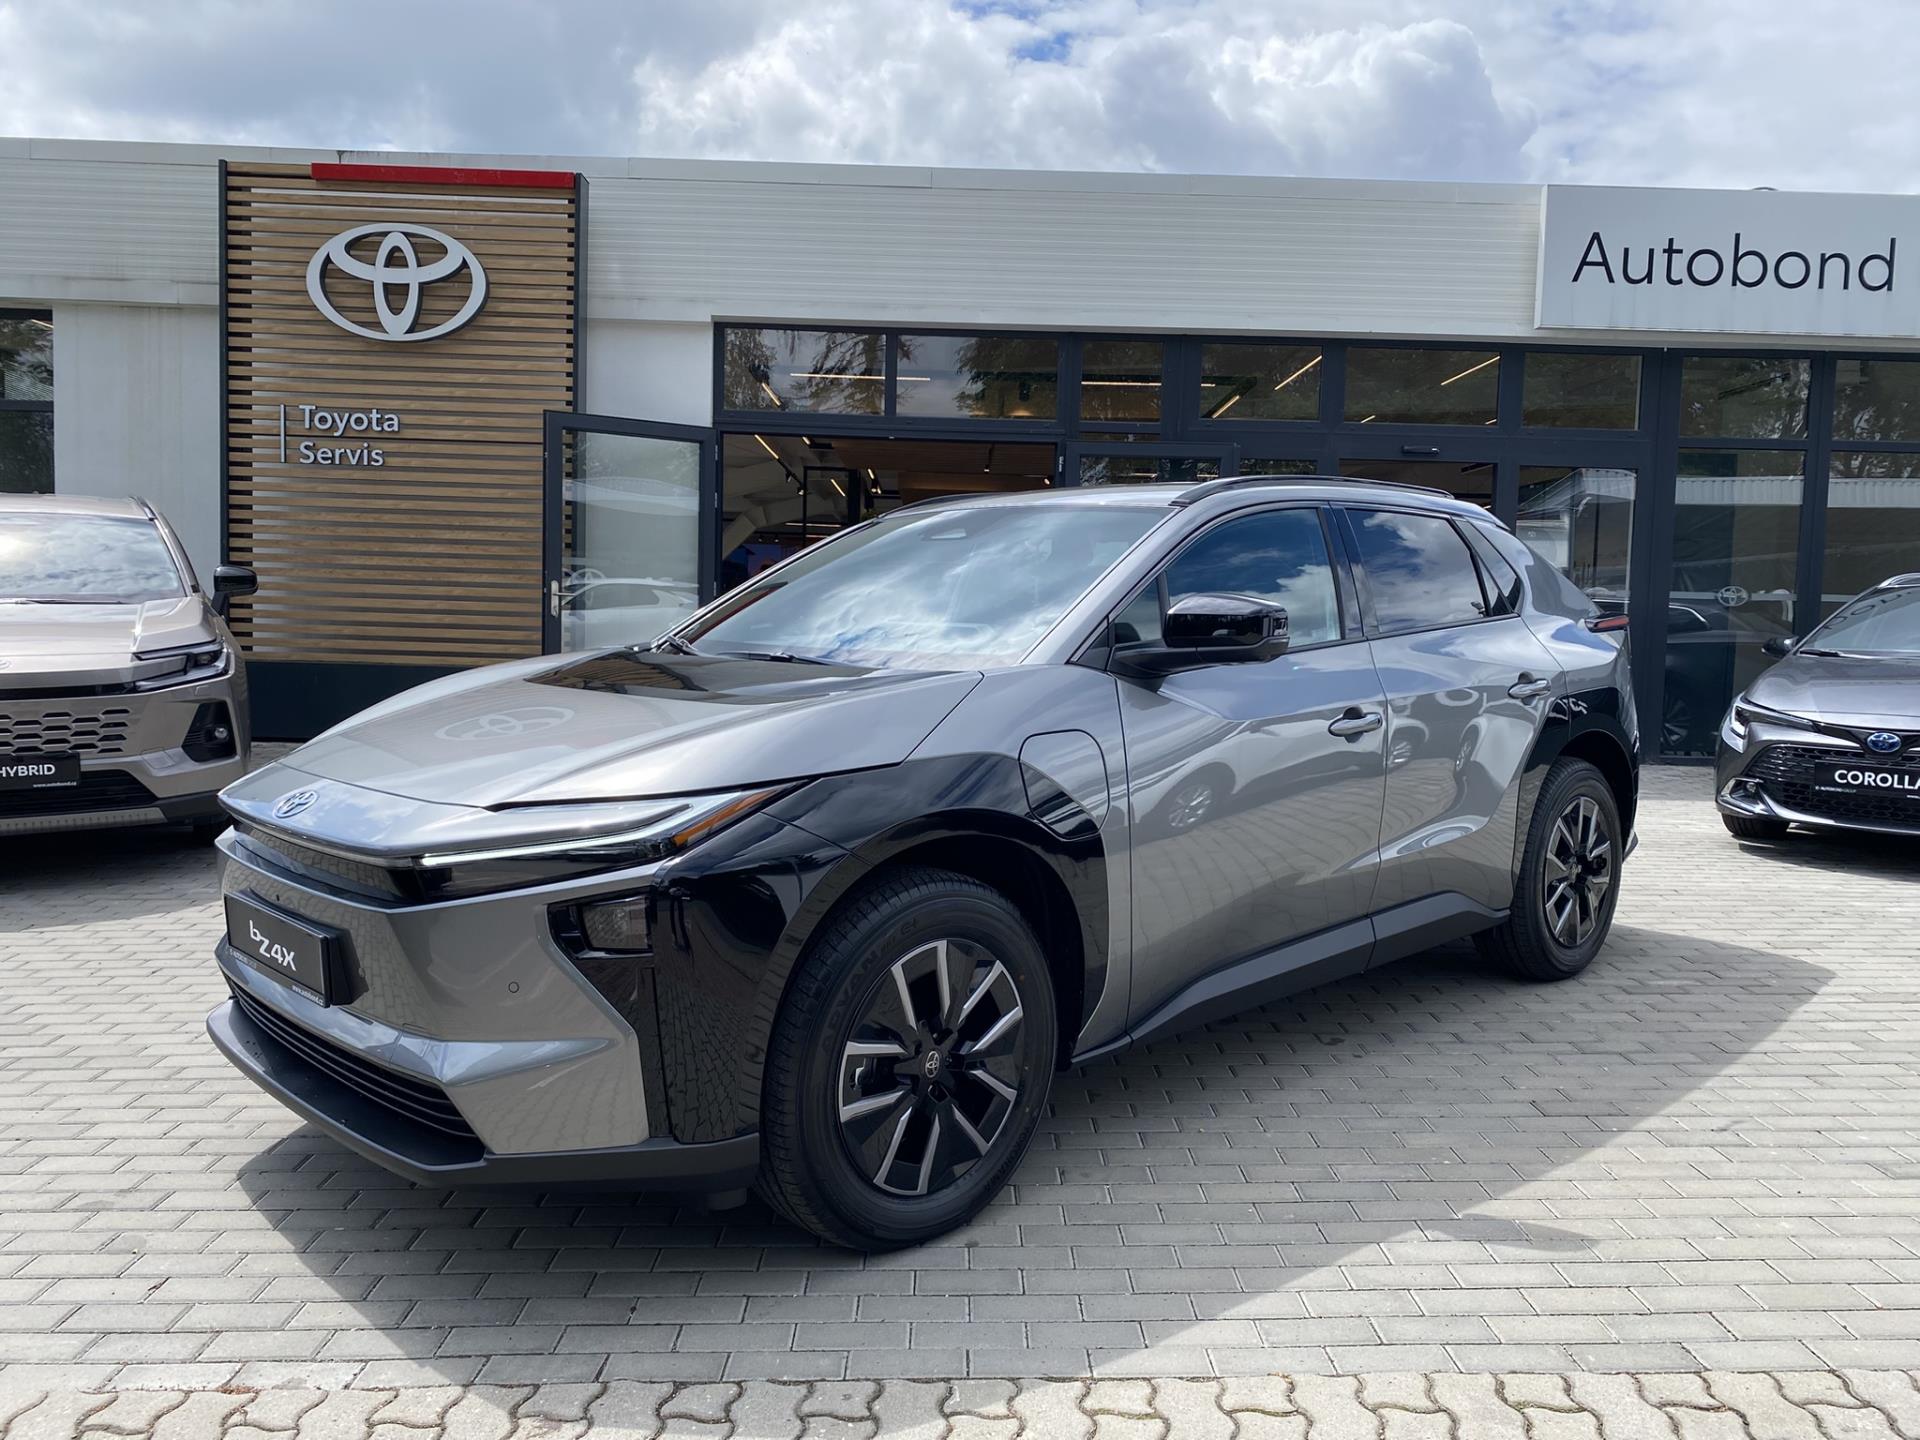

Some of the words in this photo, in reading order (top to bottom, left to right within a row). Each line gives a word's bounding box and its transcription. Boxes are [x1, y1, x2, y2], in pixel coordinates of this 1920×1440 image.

[1571, 231, 1897, 292] Autobond
[299, 405, 400, 435] Toyota
[298, 442, 385, 466] Servis
[0, 764, 56, 777] HYBRID
